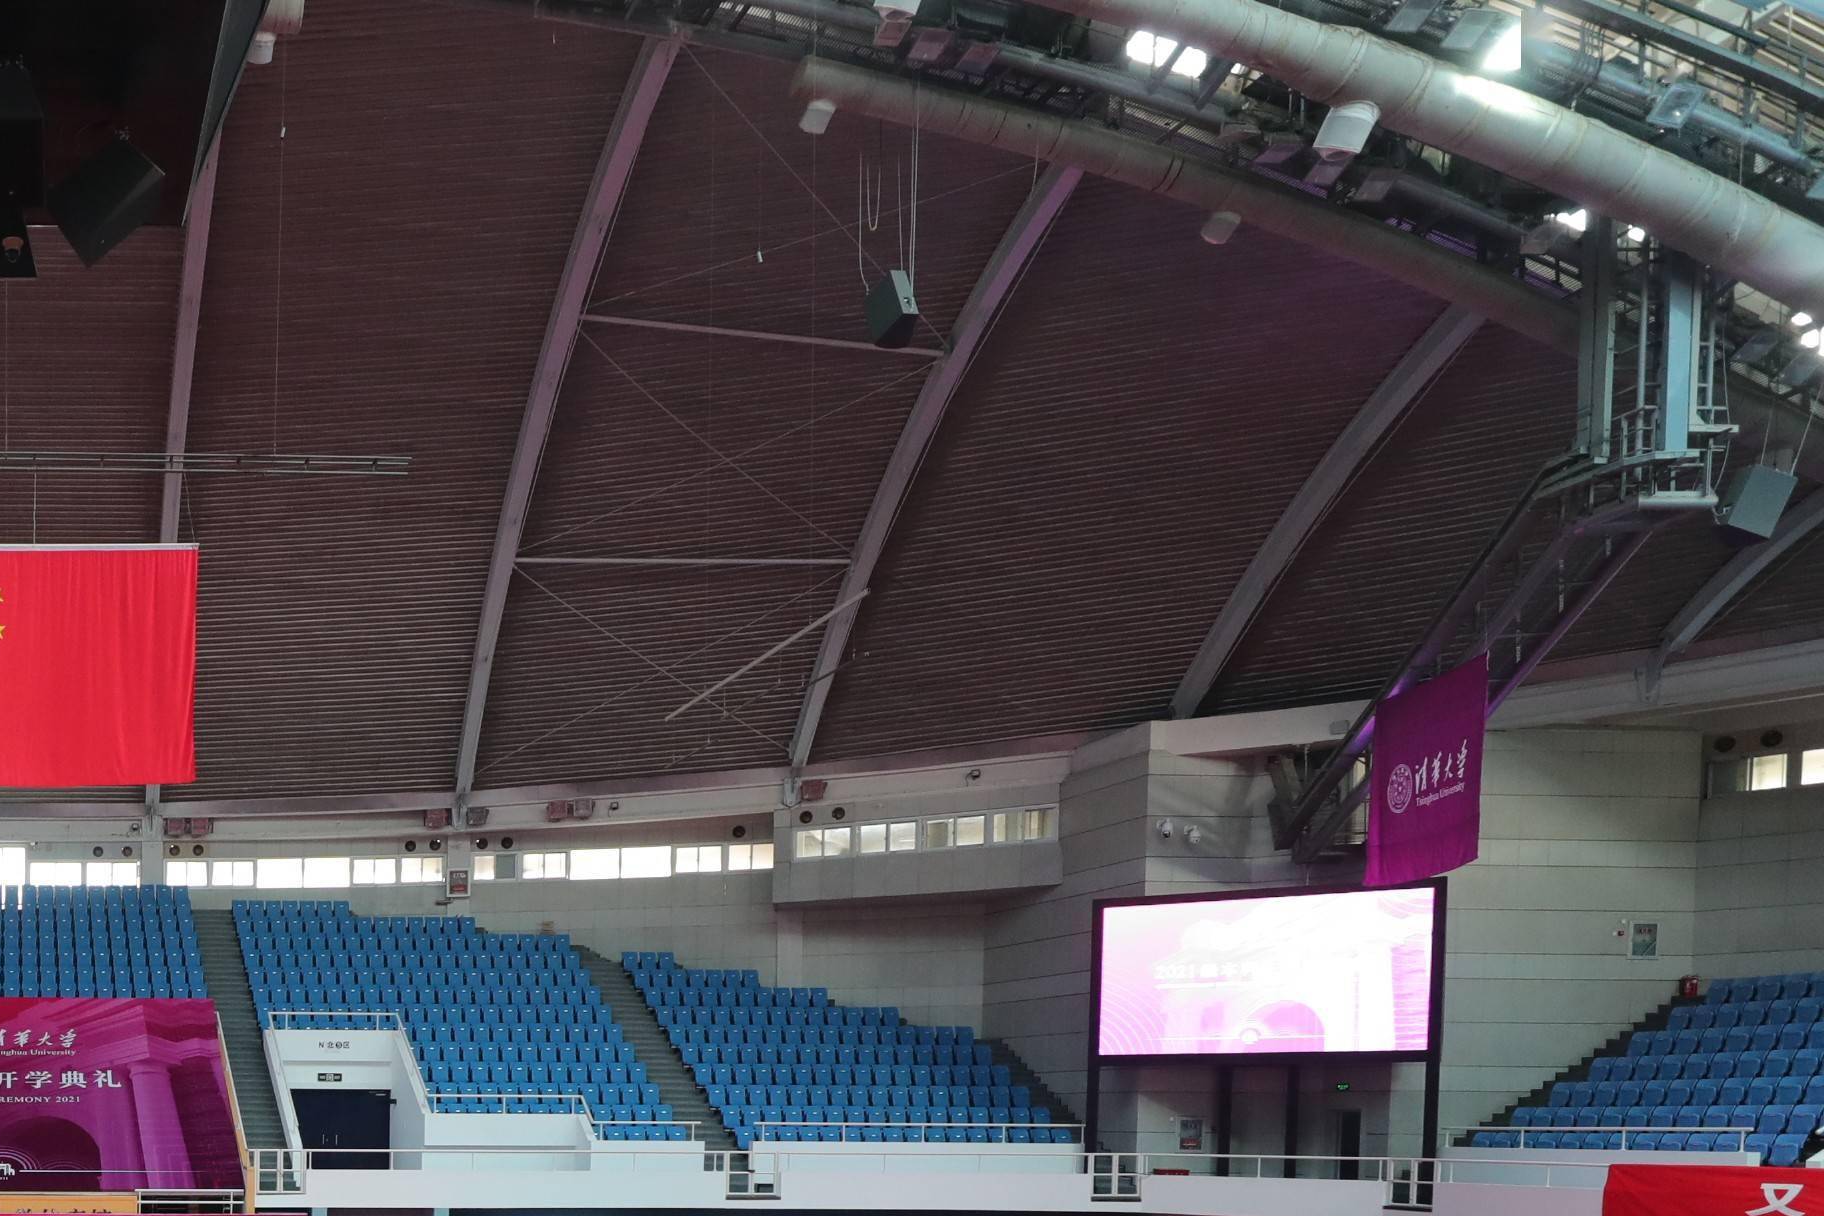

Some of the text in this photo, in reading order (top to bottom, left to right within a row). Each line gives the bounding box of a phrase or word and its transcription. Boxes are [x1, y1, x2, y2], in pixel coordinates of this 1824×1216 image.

[1415, 739, 1468, 795] 清华大学
[30, 1049, 76, 1057] University
